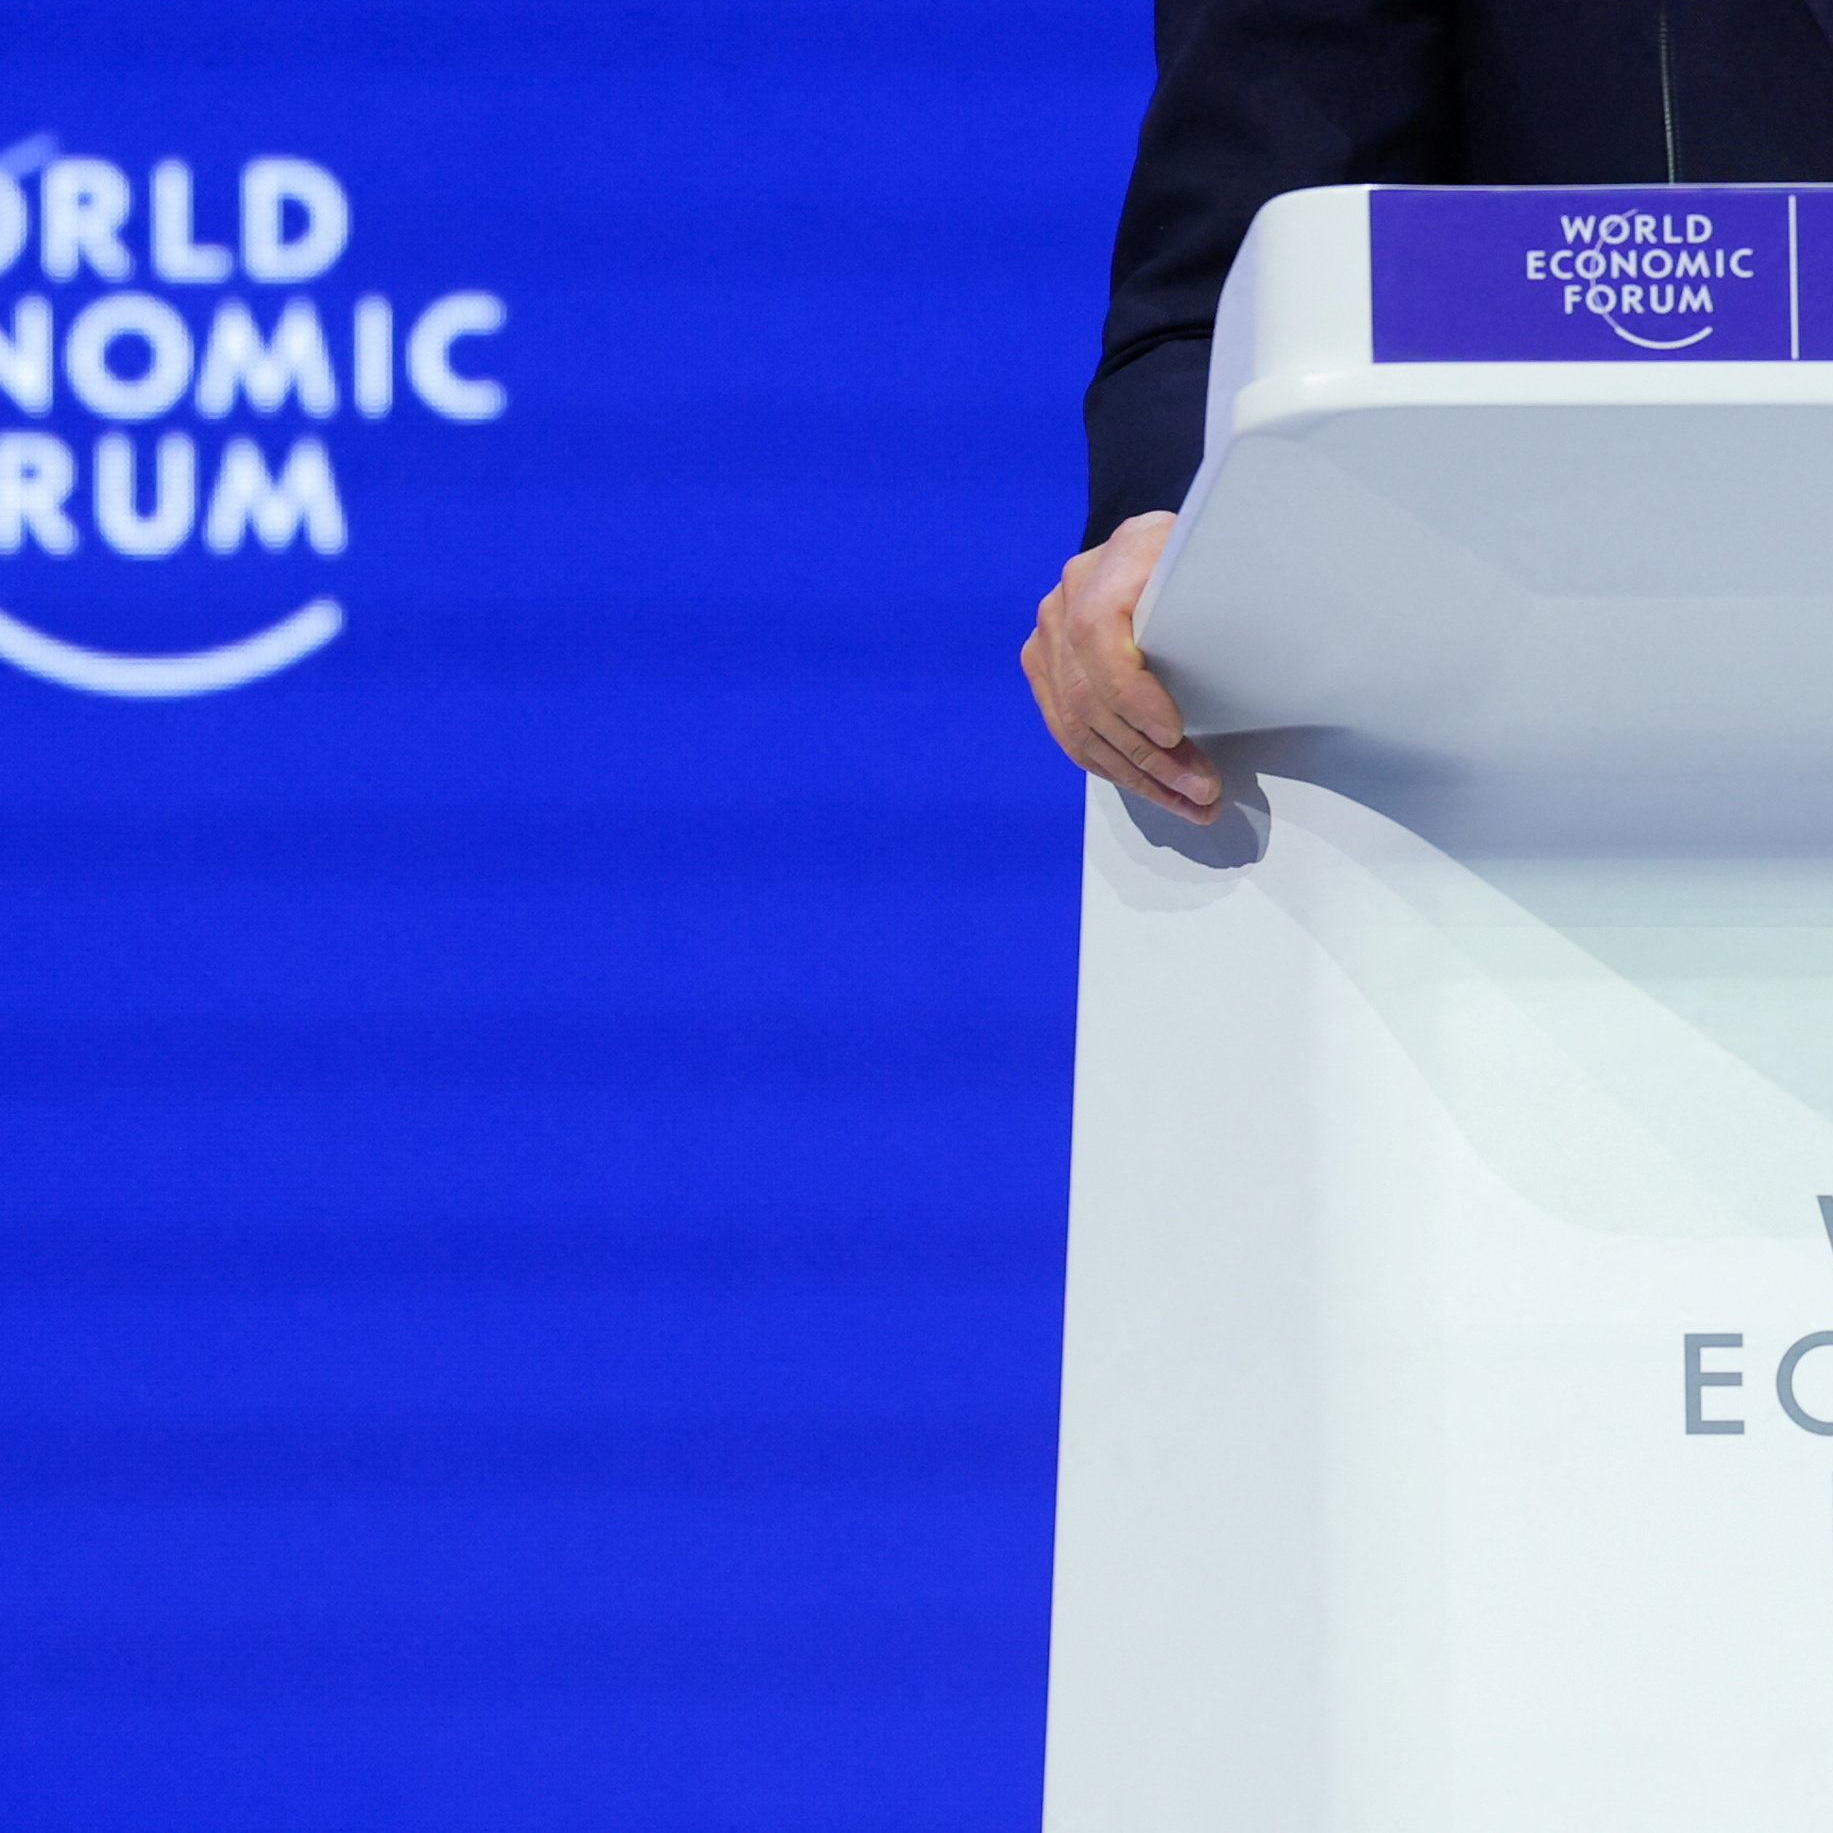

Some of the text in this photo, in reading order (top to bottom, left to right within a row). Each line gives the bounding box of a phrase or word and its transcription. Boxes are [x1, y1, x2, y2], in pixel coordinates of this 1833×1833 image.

[0, 157, 350, 284] RLD
[1560, 213, 1713, 245] WORLD
[1525, 247, 1754, 281] ECONOMIC
[1563, 283, 1714, 315] FORUM
